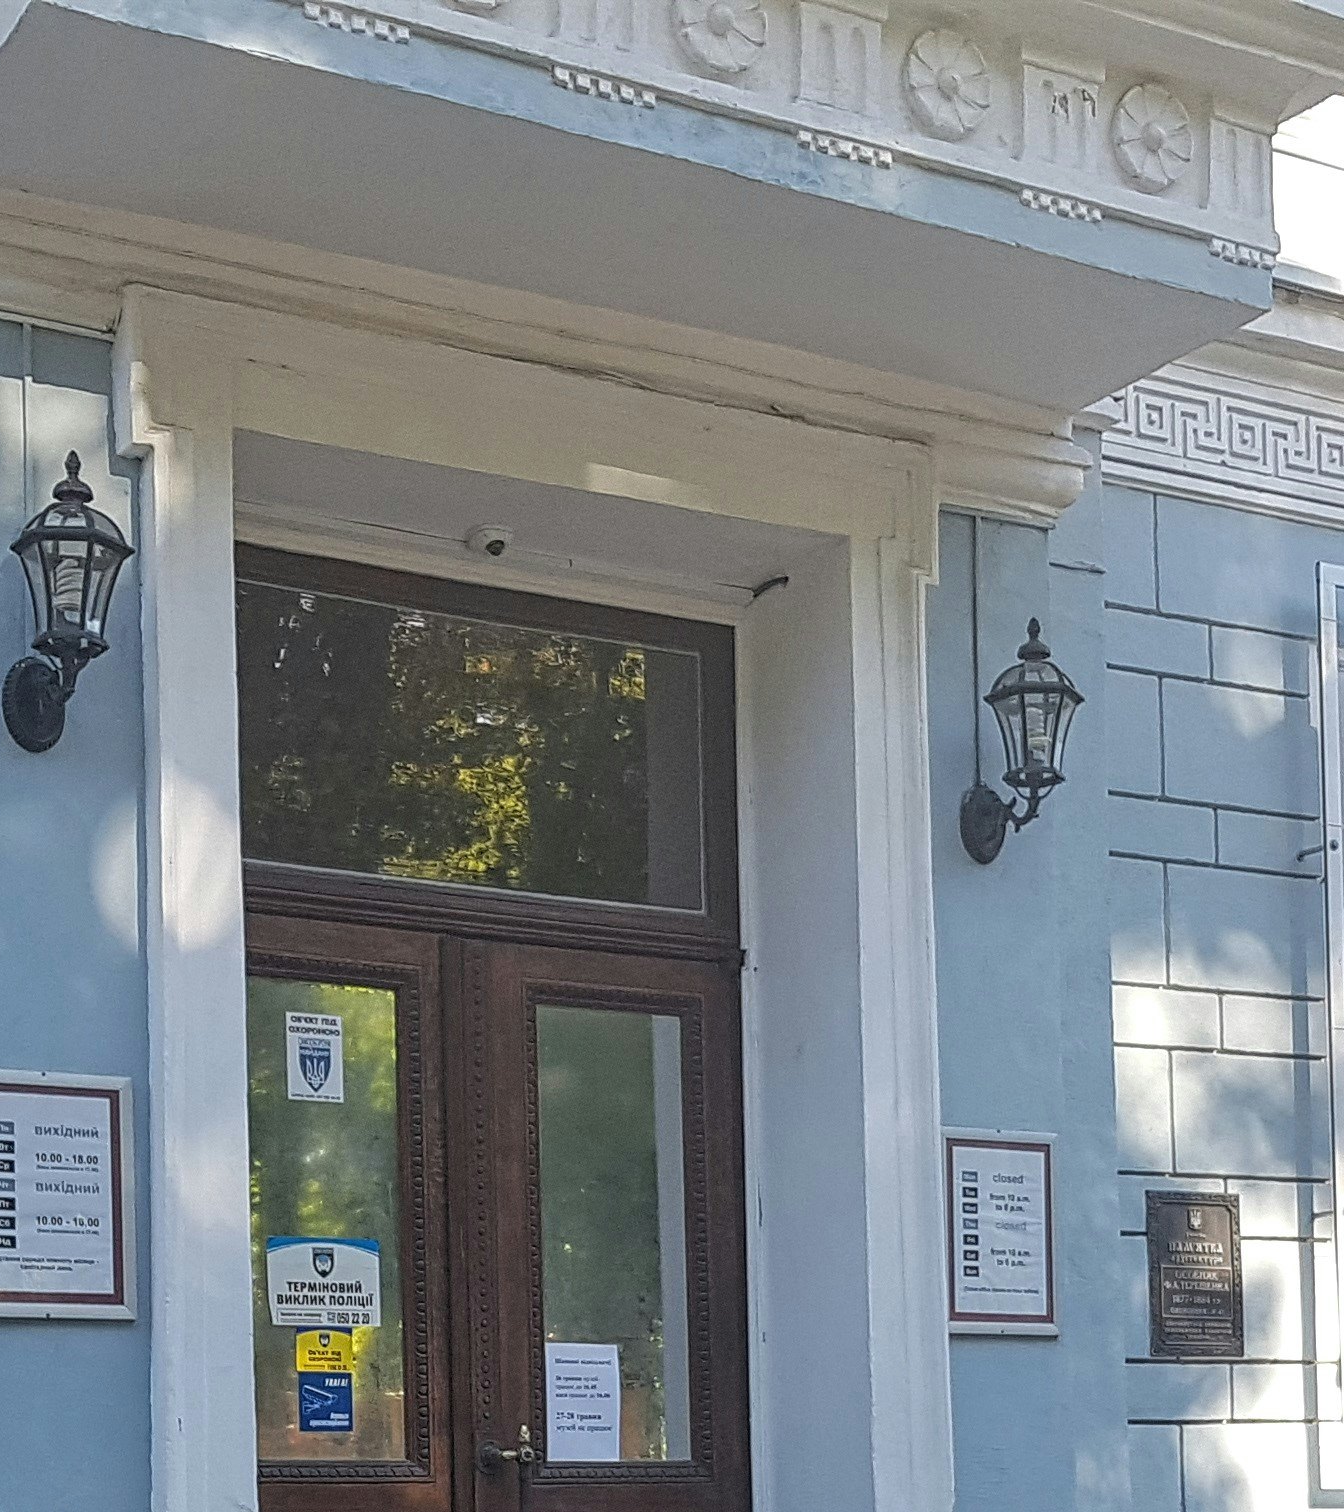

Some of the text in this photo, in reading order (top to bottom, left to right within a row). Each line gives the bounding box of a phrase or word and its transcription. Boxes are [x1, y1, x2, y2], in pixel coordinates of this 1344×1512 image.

[35, 1125, 99, 1138] вихідний
[36, 1153, 62, 1163] 10.00
[992, 1173, 1024, 1184] closed
[36, 1181, 100, 1194] вихідний
[36, 1216, 63, 1226] 10.00
[286, 1281, 362, 1294] ТЕРМІНОВИЙ
[277, 1293, 374, 1308] ВИКЛИК ПОЛІЦІЇ
